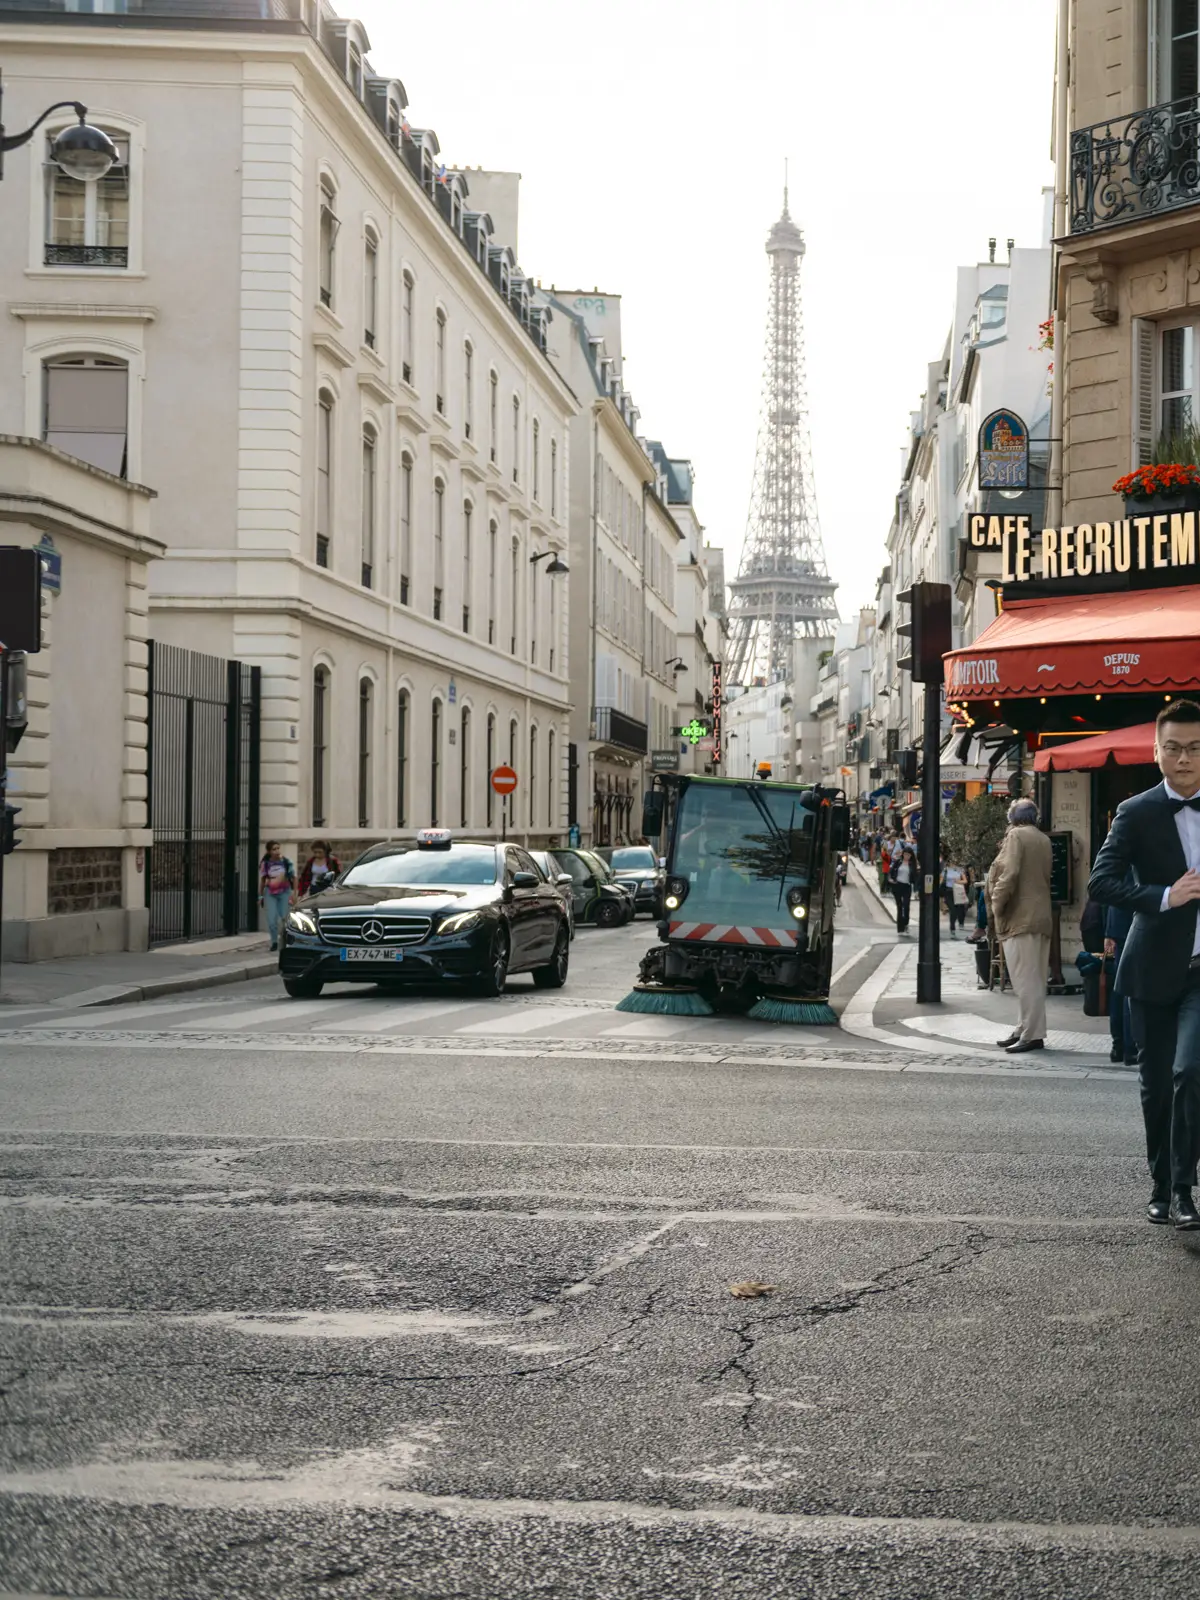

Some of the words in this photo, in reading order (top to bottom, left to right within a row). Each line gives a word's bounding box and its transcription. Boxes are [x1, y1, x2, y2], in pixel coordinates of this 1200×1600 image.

[981, 462, 1026, 485] Leffe
[1002, 532, 1030, 582] LE
[1104, 653, 1141, 667] DEPUIS
[1112, 665, 1131, 675] 1870
[347, 949, 396, 959] EX-747-ME
